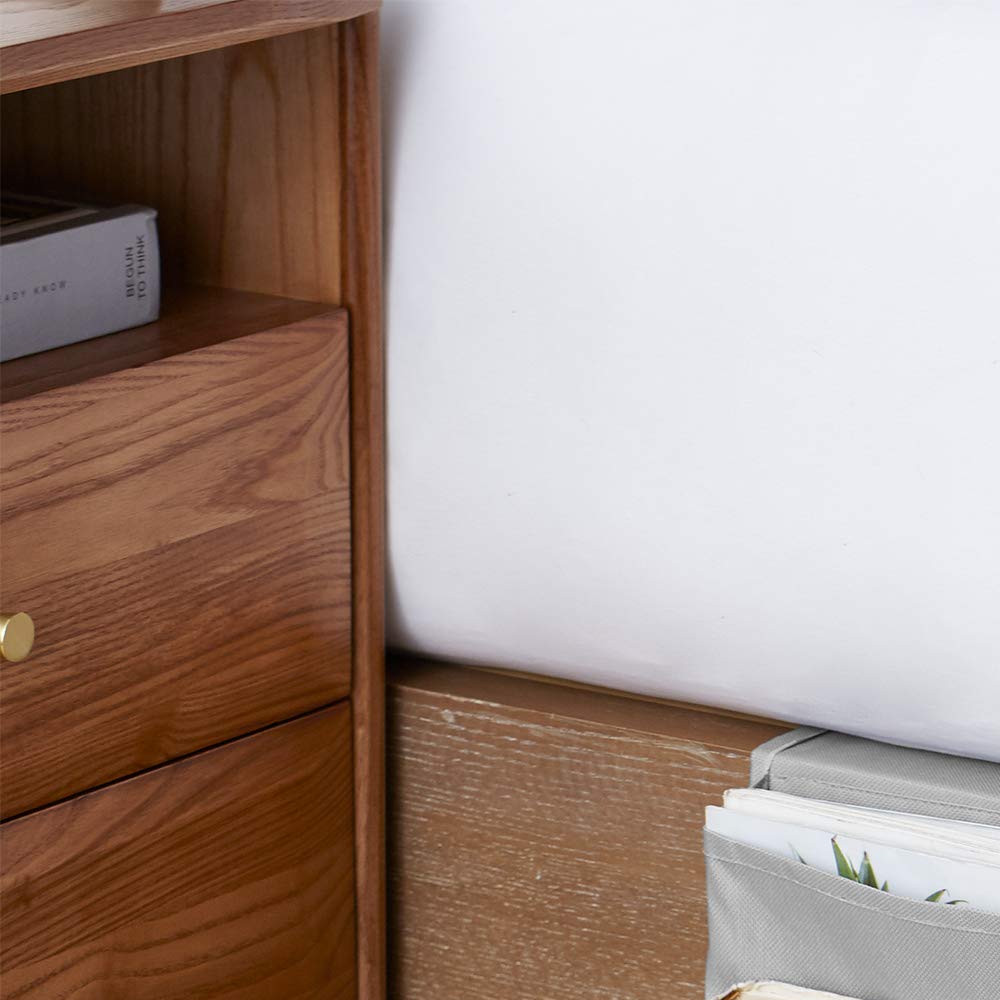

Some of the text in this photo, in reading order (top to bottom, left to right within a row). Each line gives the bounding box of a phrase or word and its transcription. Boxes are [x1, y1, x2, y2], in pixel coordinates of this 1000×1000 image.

[125, 246, 135, 298] BEGUN
[136, 234, 147, 299] TO THINK
